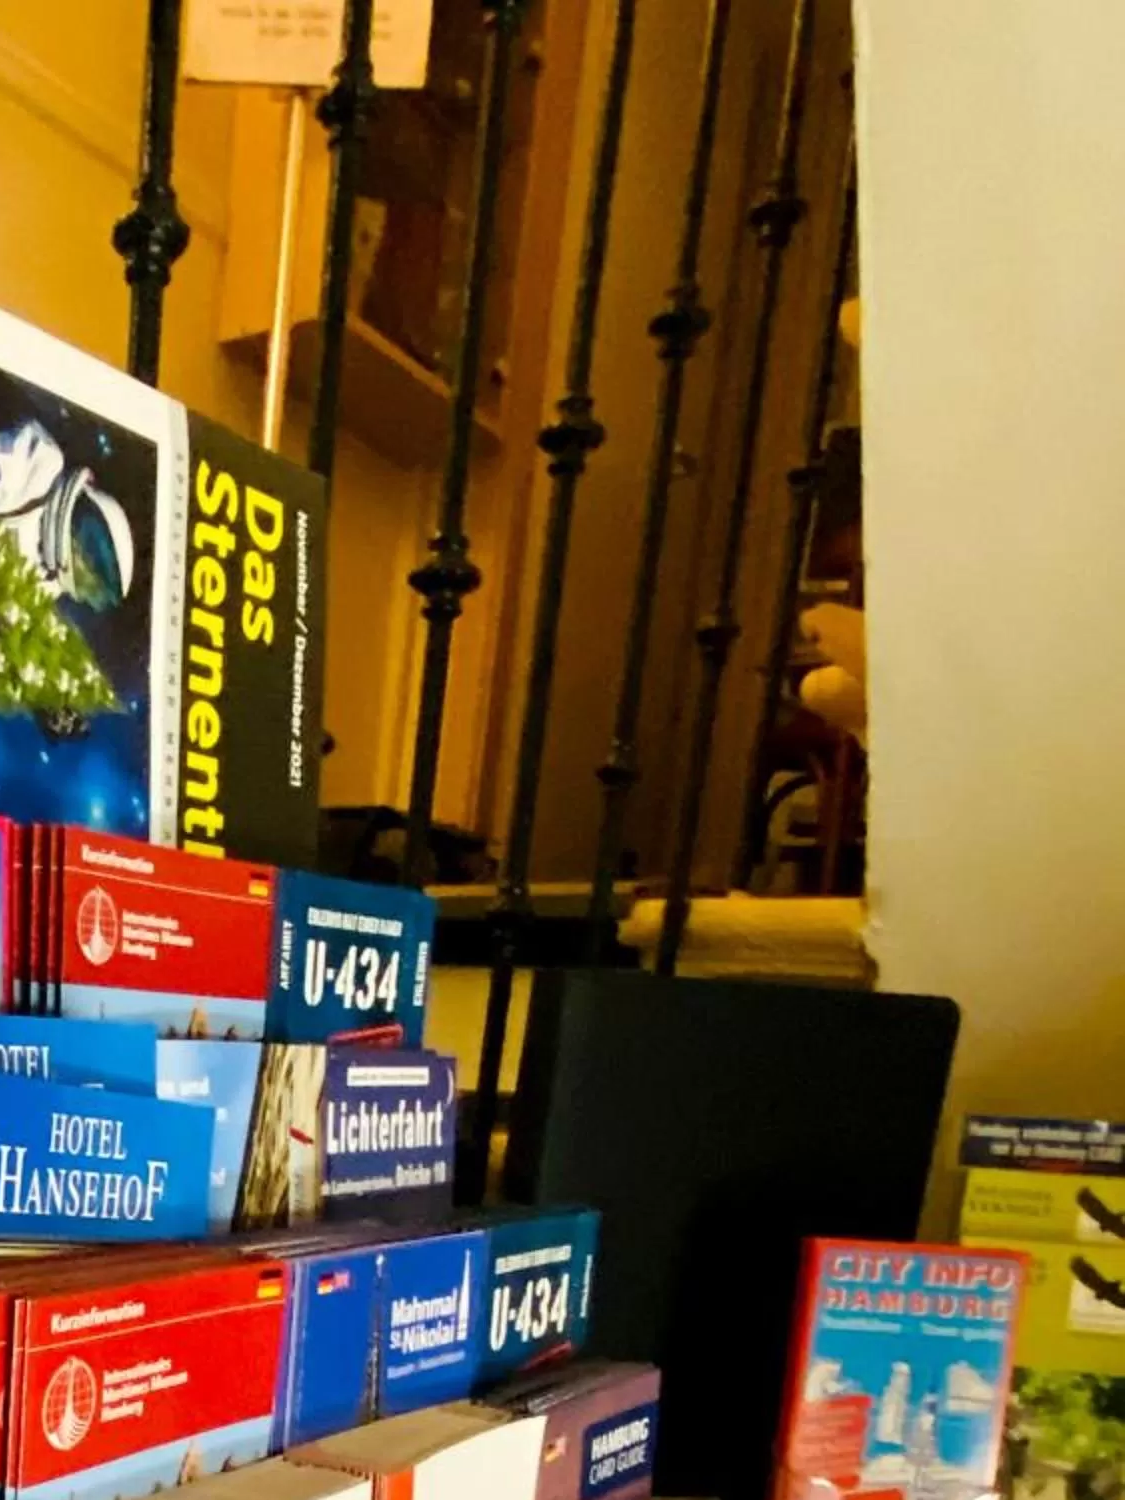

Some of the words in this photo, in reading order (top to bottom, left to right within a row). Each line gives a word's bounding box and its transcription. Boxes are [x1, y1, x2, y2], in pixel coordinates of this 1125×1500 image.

[241, 484, 284, 646] Das
[295, 509, 309, 617] November
[290, 634, 308, 737] Dezember
[289, 739, 303, 788] 2021
[303, 939, 400, 1014] U-434
[49, 1112, 127, 1160] HOTEL
[326, 1099, 444, 1155] Lichterfahrt
[831, 1253, 915, 1285] CITY
[926, 1259, 1016, 1292] INFO
[489, 1272, 571, 1352] U-434
[825, 1287, 1009, 1322] HAMBURG
[591, 1416, 650, 1461] HAMBURG
